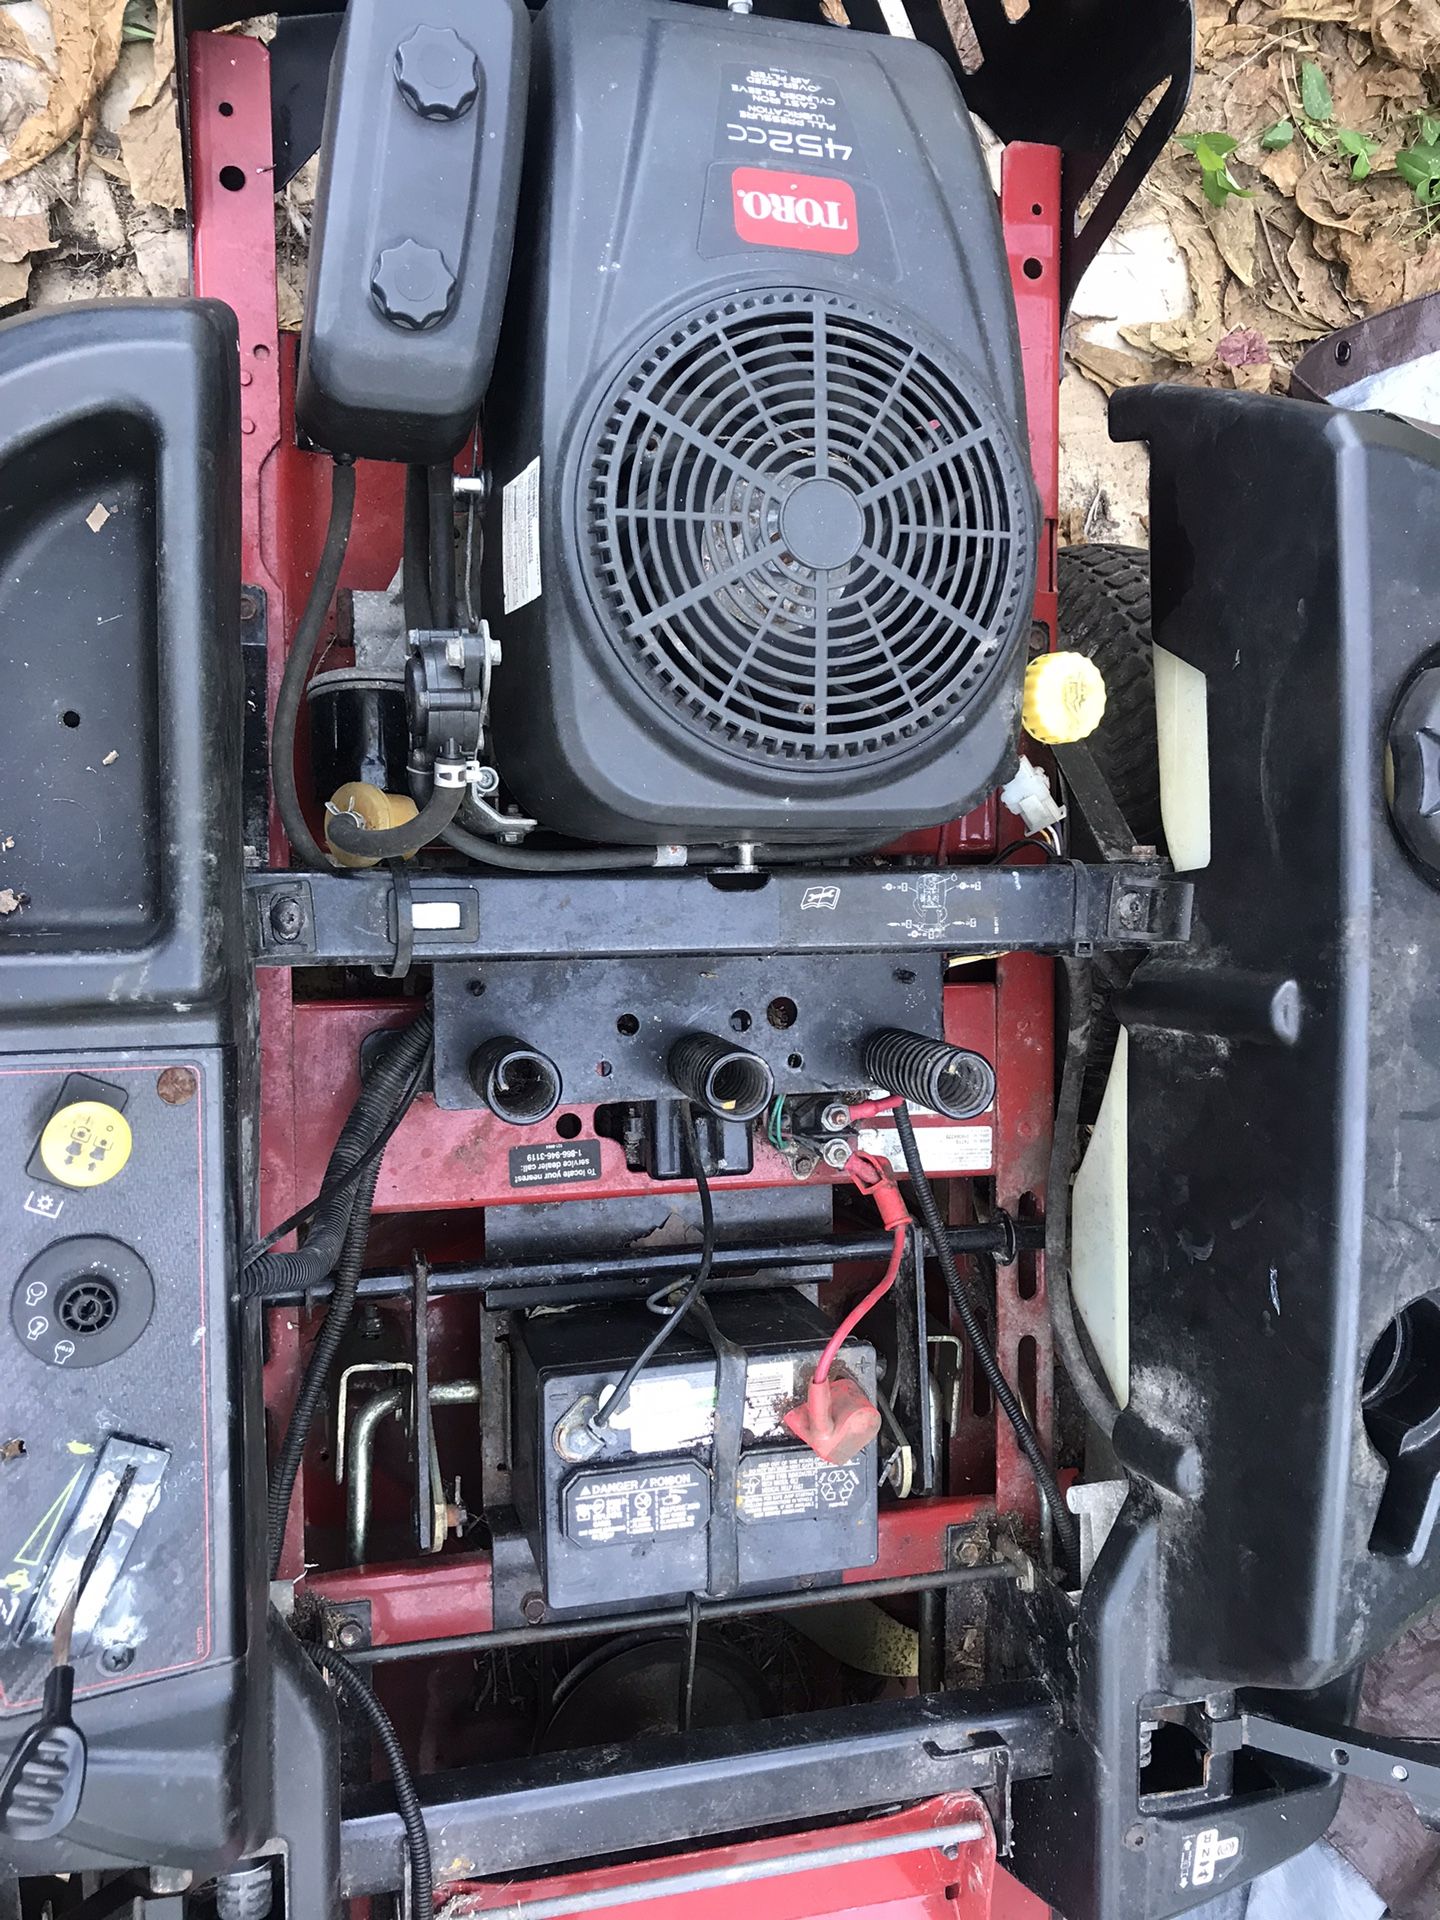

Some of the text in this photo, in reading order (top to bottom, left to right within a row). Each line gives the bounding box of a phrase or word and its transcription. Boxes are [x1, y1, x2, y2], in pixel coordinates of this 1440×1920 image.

[750, 70, 787, 81] FILTER
[790, 76, 811, 84] AIR
[746, 76, 818, 92] OVER-SIZED
[731, 84, 836, 106] CYLINDER SLEEVE
[752, 94, 818, 110] CAST IRON
[739, 110, 836, 131] FULL PRESSURE
[748, 104, 825, 122] LUBRICATION
[727, 123, 853, 160] 452cc
[742, 191, 848, 230] TORO
[538, 1162, 561, 1170] dealer
[563, 1158, 590, 1167] service
[514, 1168, 596, 1183] To locate your nearest
[592, 1480, 638, 1494] DANGER
[650, 1474, 690, 1487] POISON
[1204, 1834, 1211, 1843] R
